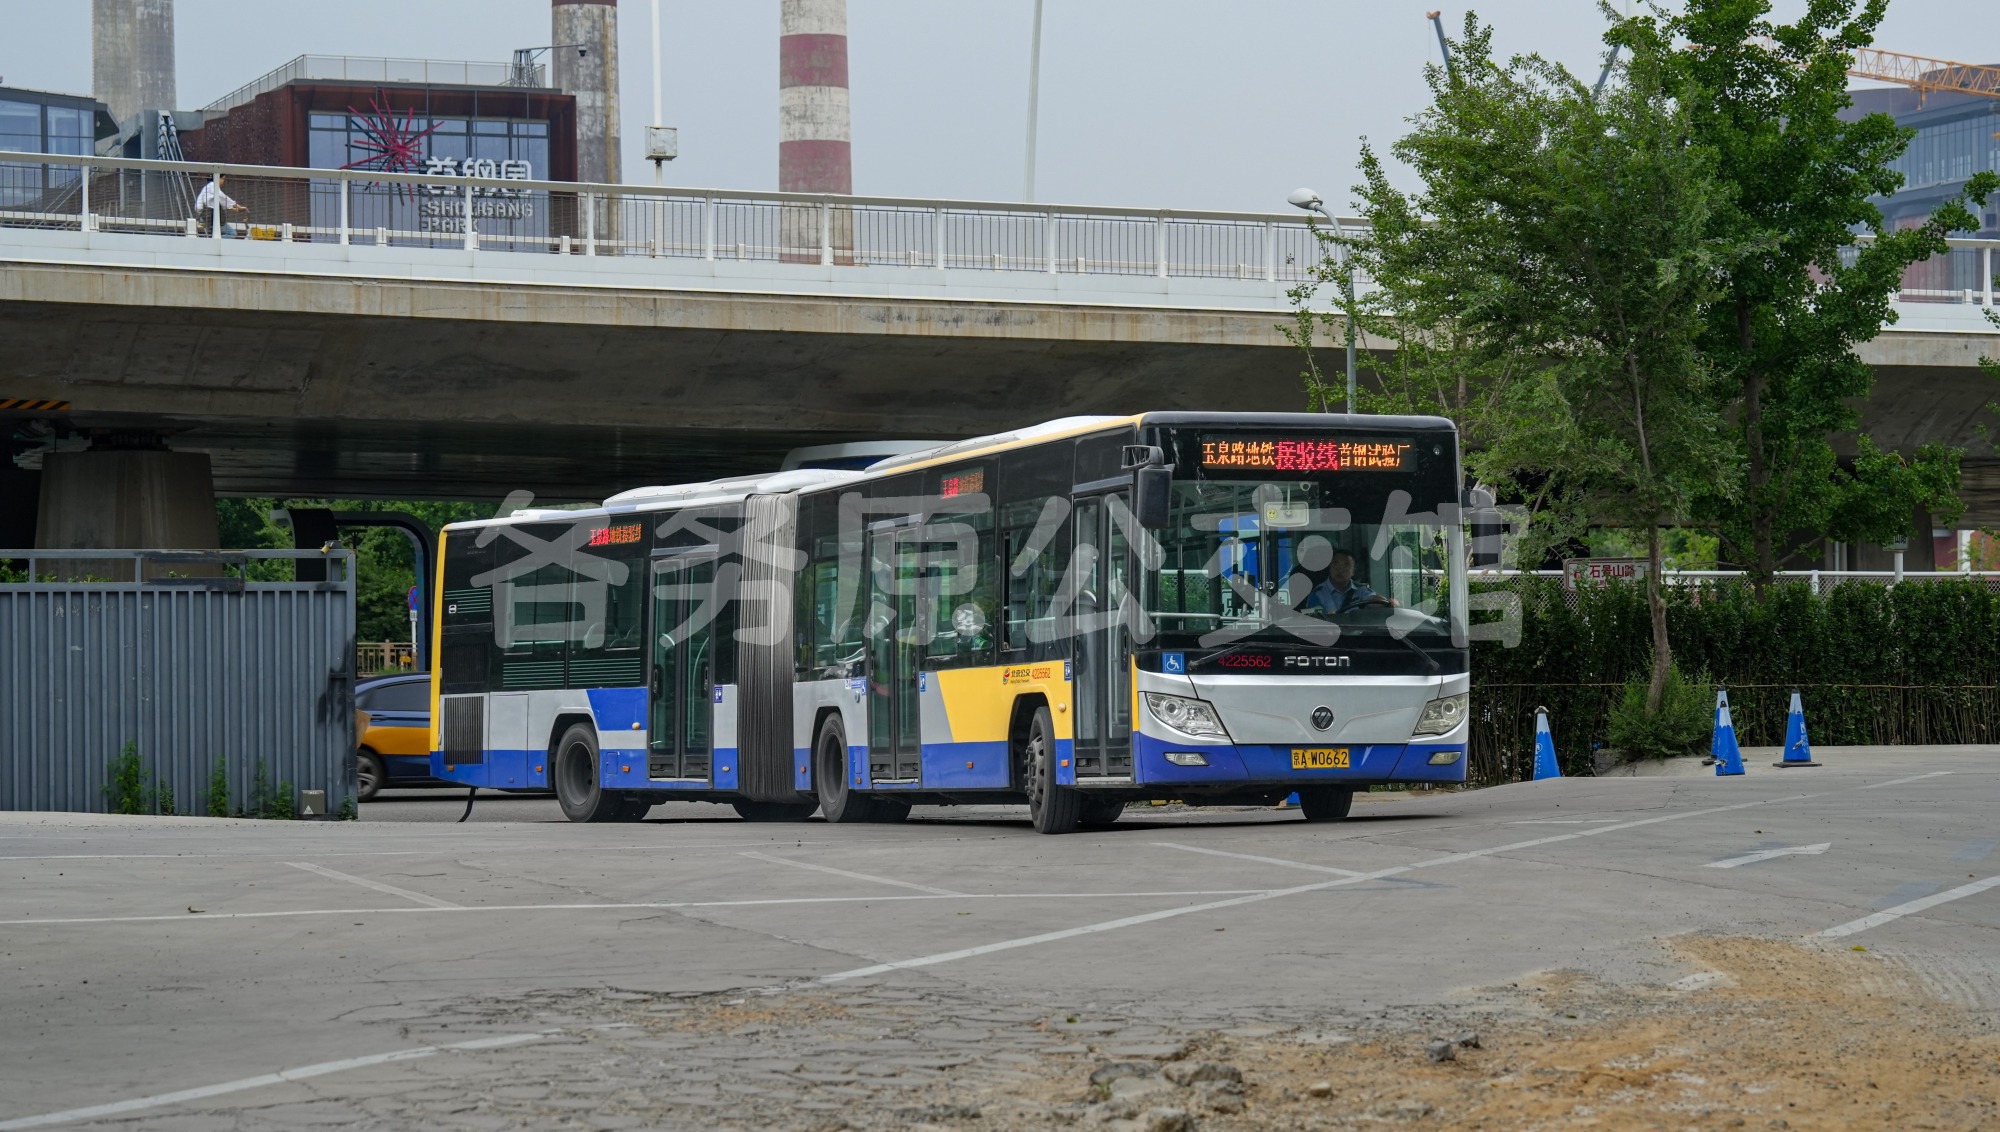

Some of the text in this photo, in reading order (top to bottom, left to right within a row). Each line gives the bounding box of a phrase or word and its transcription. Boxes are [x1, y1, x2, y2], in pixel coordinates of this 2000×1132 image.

[426, 156, 532, 196] 首钢园
[1218, 655, 1272, 667] 4225562
[1284, 656, 1350, 667] FOTON
